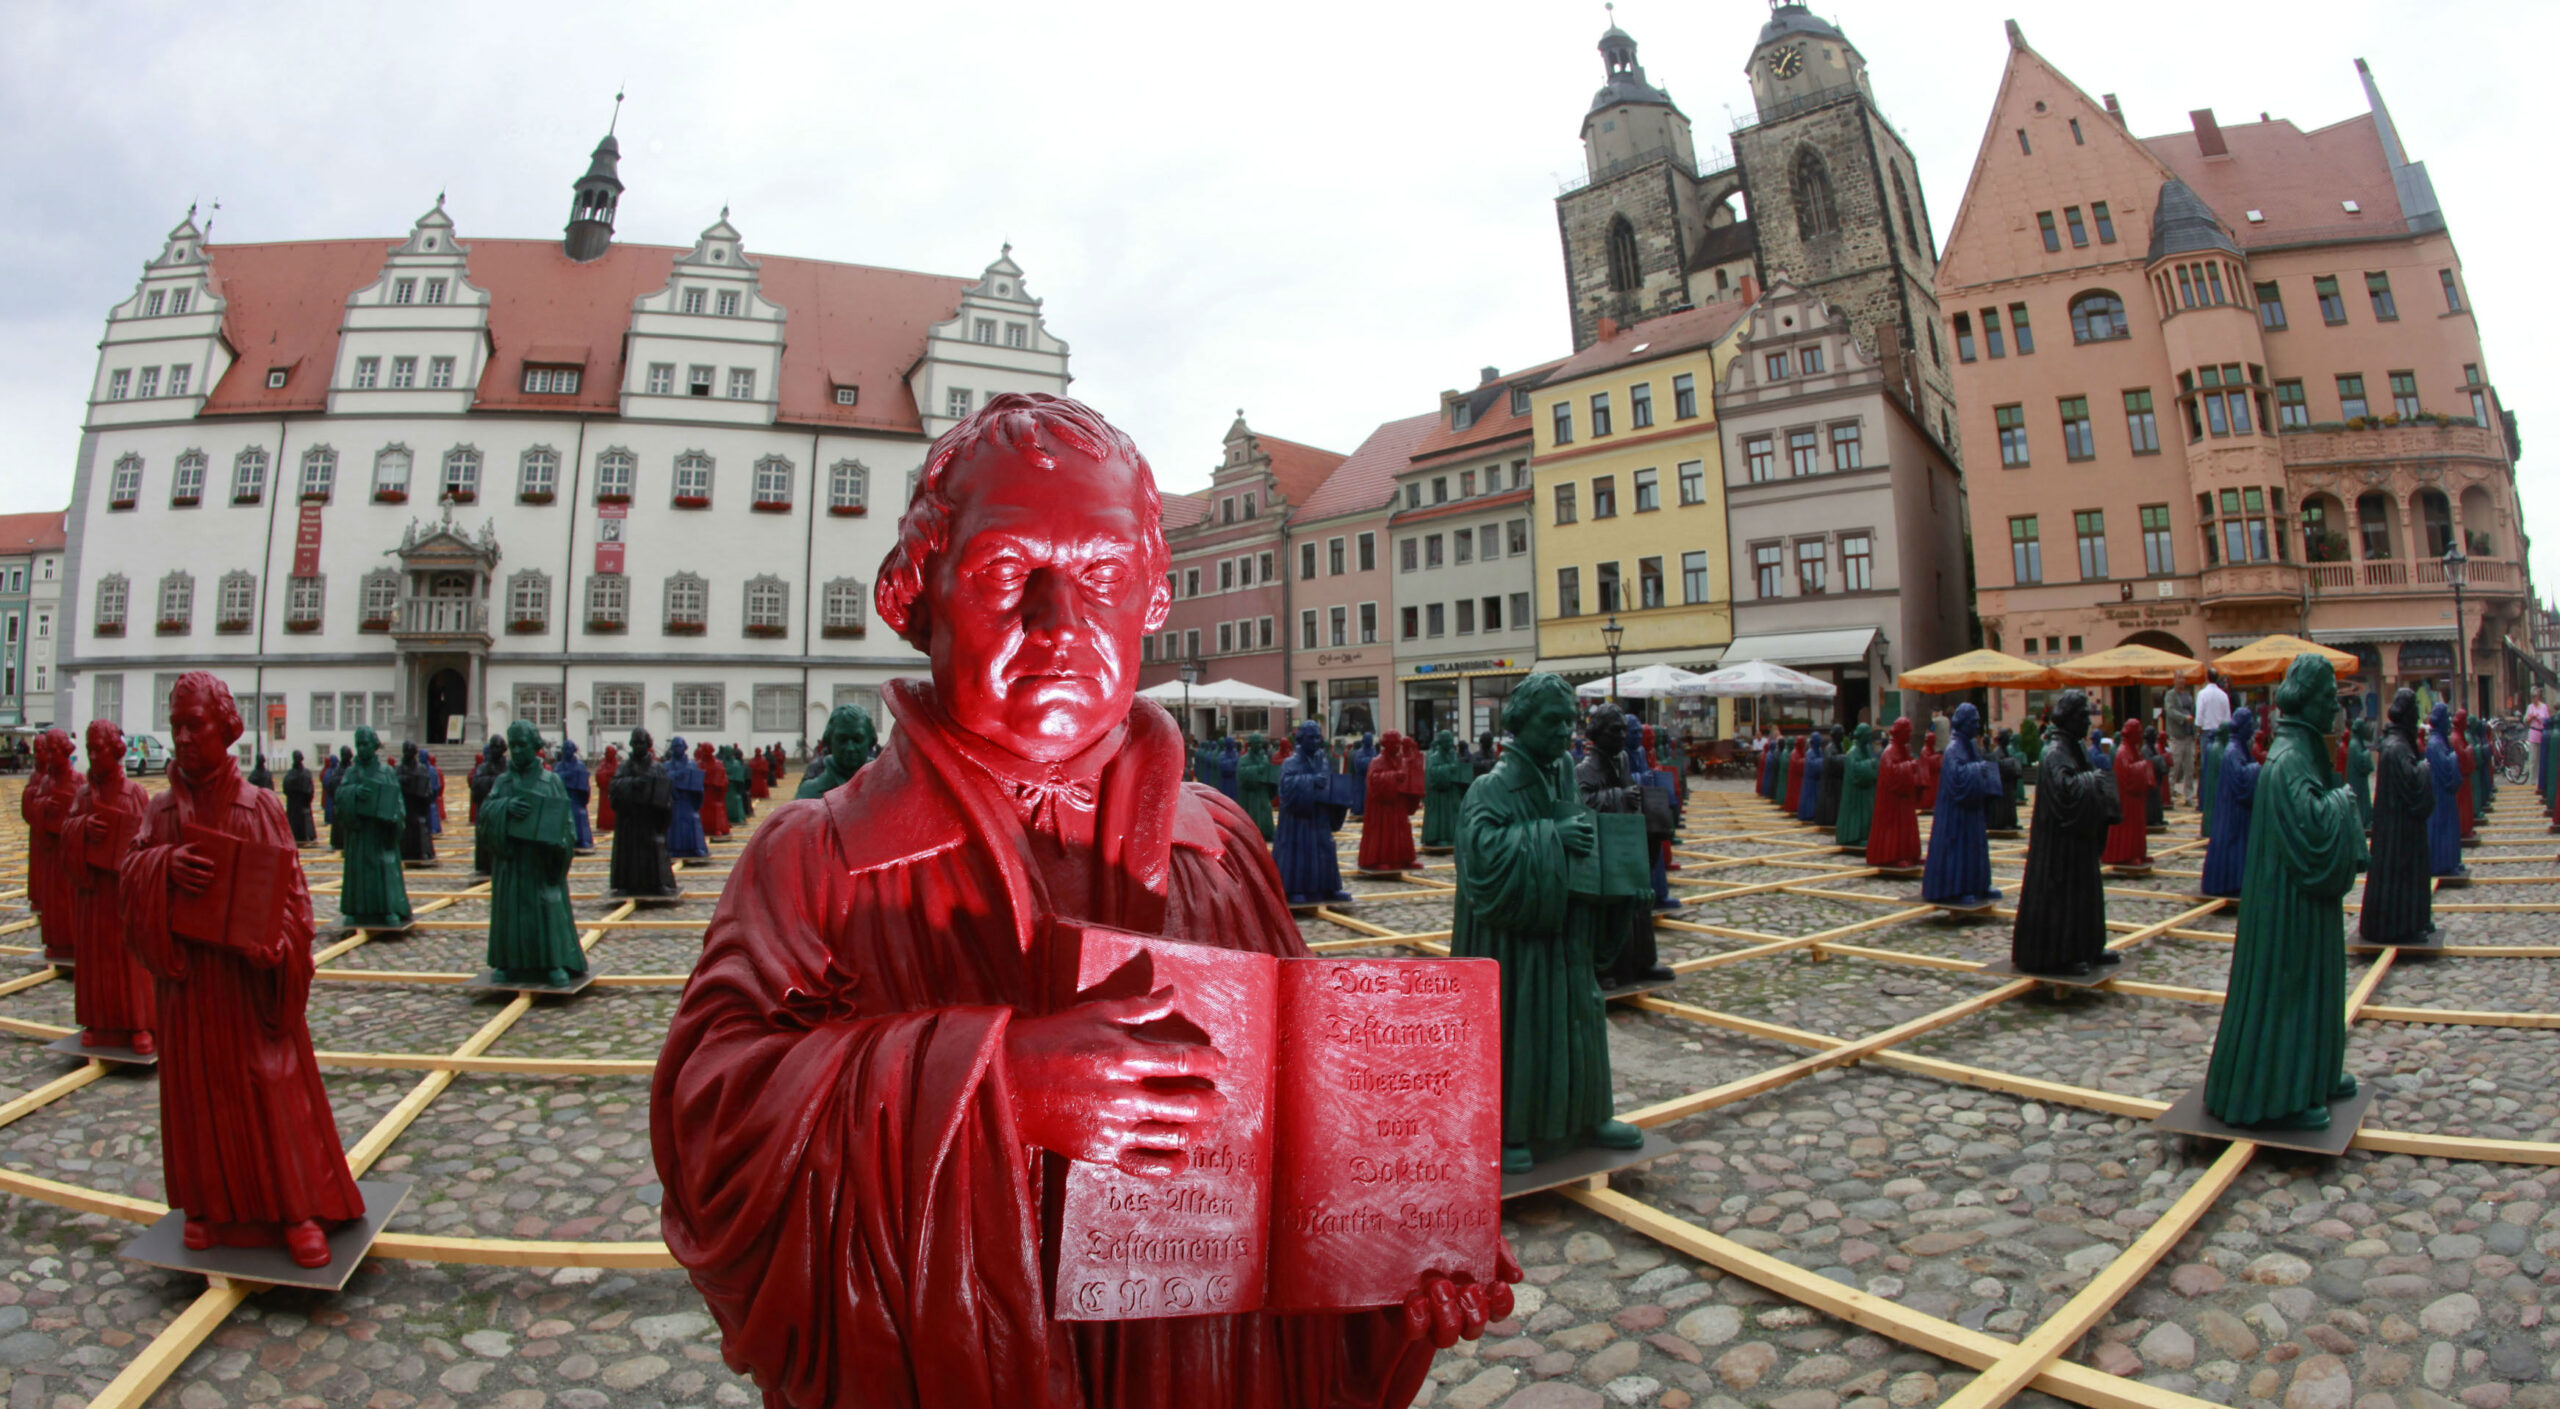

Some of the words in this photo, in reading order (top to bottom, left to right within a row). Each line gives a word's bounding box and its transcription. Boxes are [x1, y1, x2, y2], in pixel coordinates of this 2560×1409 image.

[1331, 966, 1389, 995] Das
[1400, 968, 1462, 996] Neue
[1348, 1066, 1453, 1097] übersetzt
[1376, 1118, 1420, 1138] von
[1191, 1144, 1258, 1176] ücher
[1349, 1153, 1452, 1185] Doktor
[1109, 1186, 1150, 1213] des
[1166, 1187, 1234, 1217] Alten
[1288, 1204, 1385, 1235] Martin
[1399, 1202, 1490, 1236] Luther
